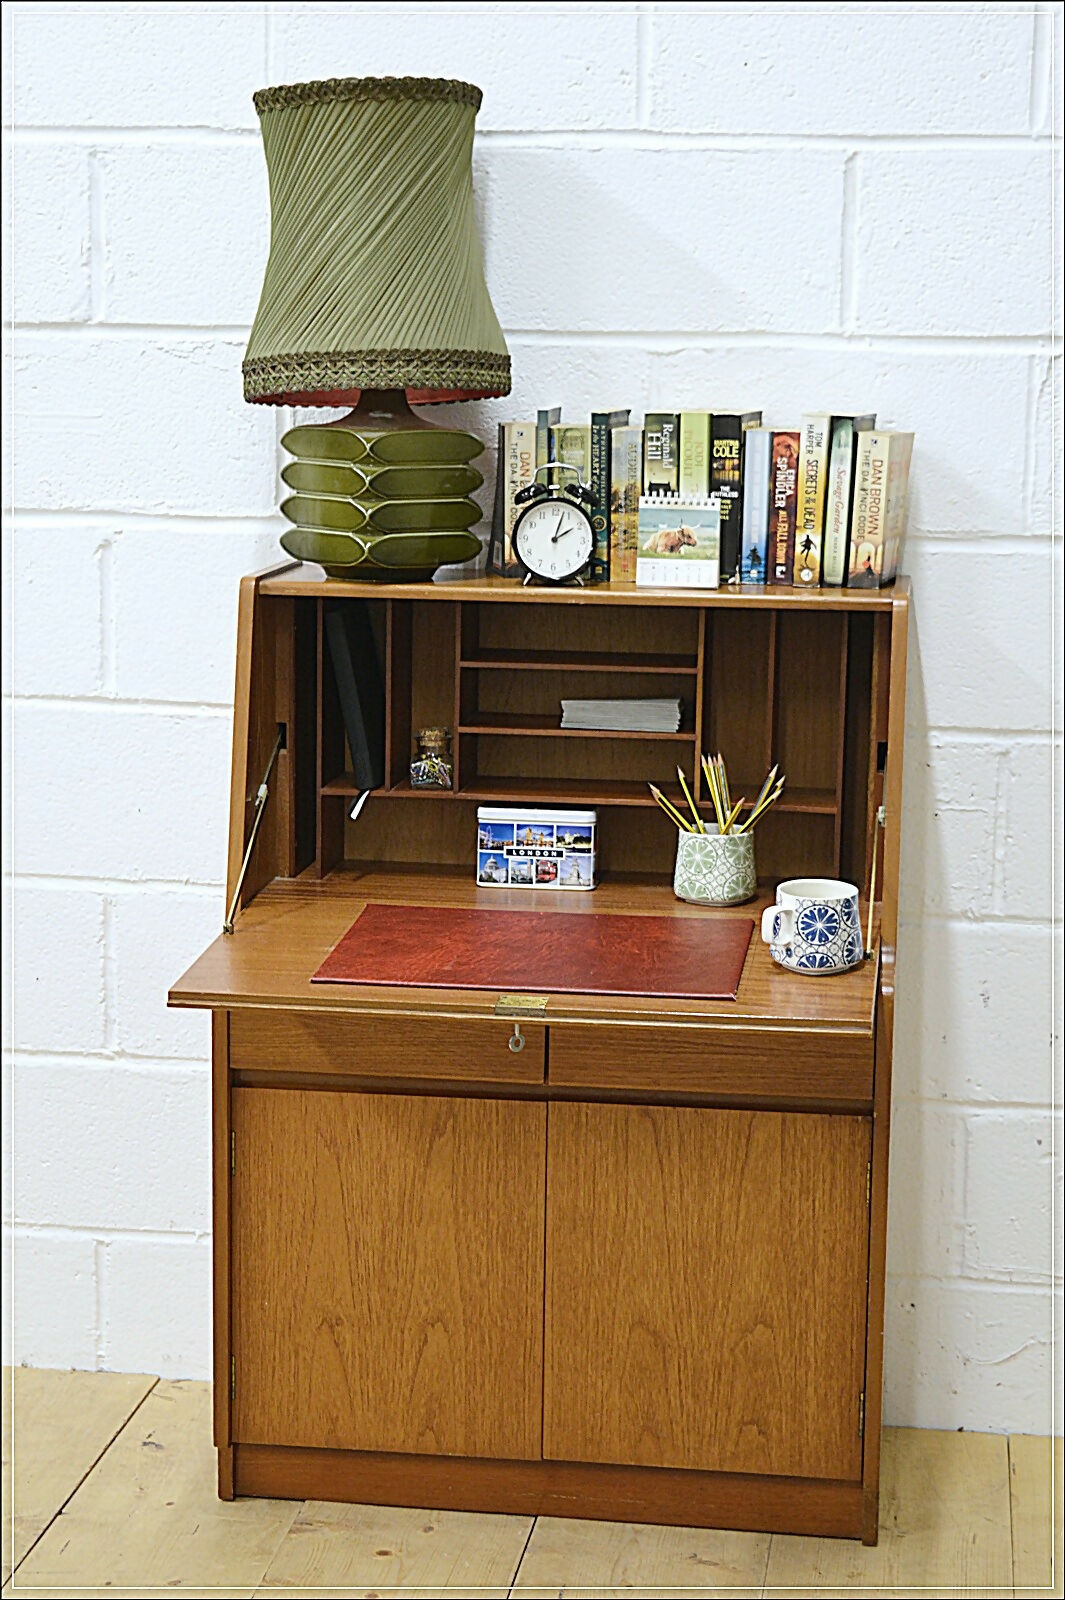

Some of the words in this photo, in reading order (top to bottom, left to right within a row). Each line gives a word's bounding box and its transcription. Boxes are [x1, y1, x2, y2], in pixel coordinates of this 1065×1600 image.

[510, 442, 518, 460] THE
[648, 432, 662, 460] Hill
[660, 423, 674, 469] Reginald
[713, 446, 739, 457] COLE
[805, 424, 815, 455] HARPER
[815, 432, 823, 448] TOM
[520, 452, 531, 476] DAN
[592, 444, 600, 475] HEART
[684, 430, 693, 478] PICOULT
[695, 441, 704, 467] JODI
[861, 449, 871, 468] THE
[774, 457, 787, 508] SPINDLER
[785, 469, 796, 496] ERICA
[804, 459, 818, 495] SECRETS
[833, 467, 847, 501] Savage
[861, 470, 870, 482] DA
[871, 459, 884, 485] DAN
[778, 510, 787, 523] ALL
[803, 507, 816, 530] DEAD
[832, 500, 844, 534] Garden
[867, 488, 882, 535] BROWN
[776, 523, 789, 542] FALL
[856, 515, 867, 541] CODE
[550, 563, 557, 571] 6
[512, 849, 557, 857] LONDON
